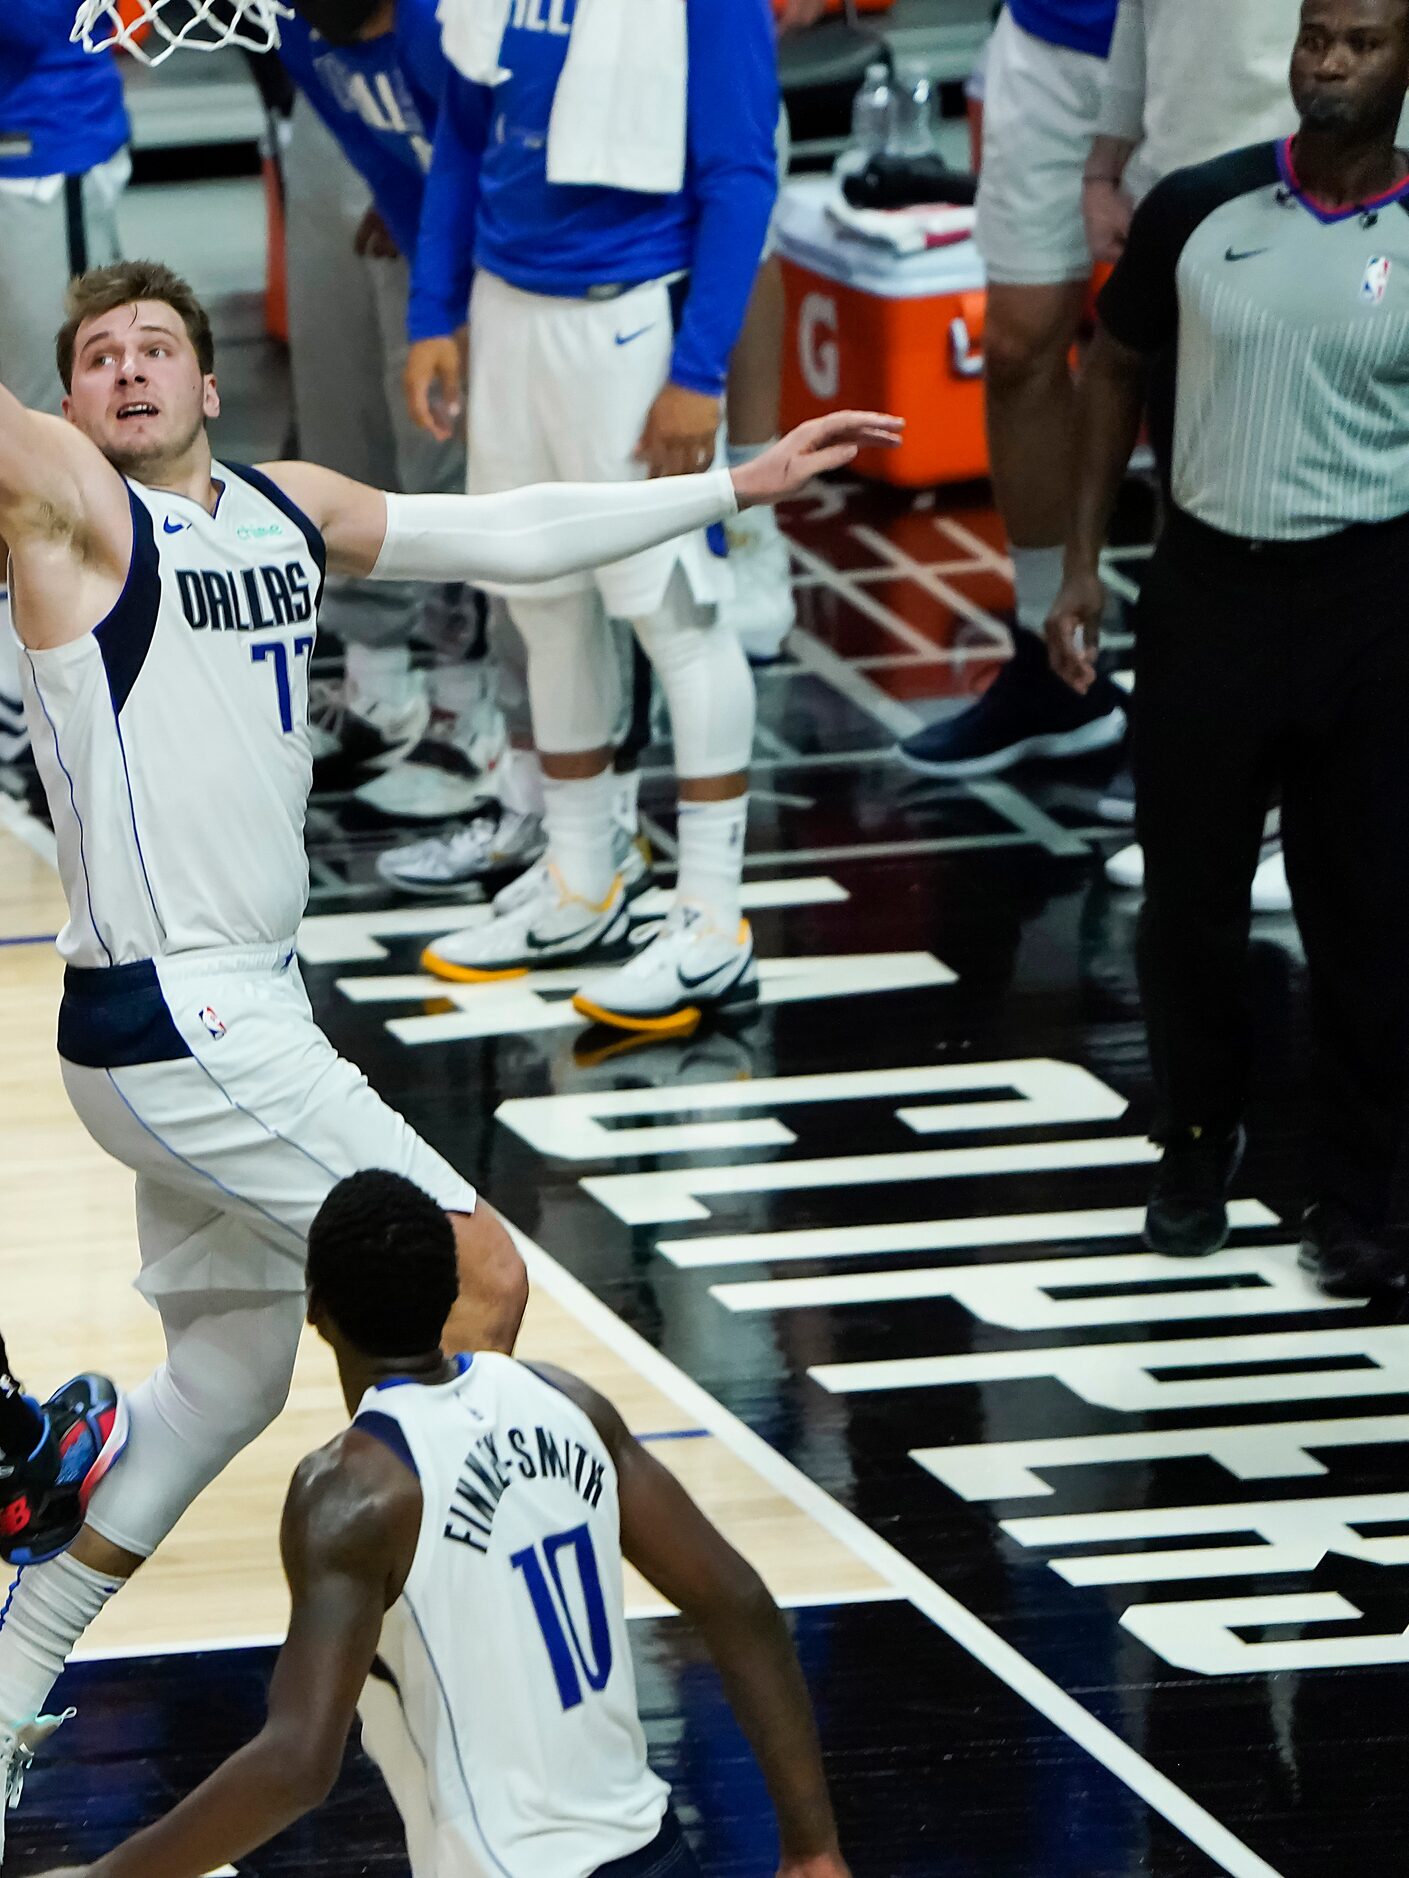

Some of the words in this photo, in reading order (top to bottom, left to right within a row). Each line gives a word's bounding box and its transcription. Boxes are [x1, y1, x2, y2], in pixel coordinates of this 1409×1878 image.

[798, 292, 839, 400] G
[174, 560, 313, 632] DALLAS
[510, 1522, 613, 1713] 10
